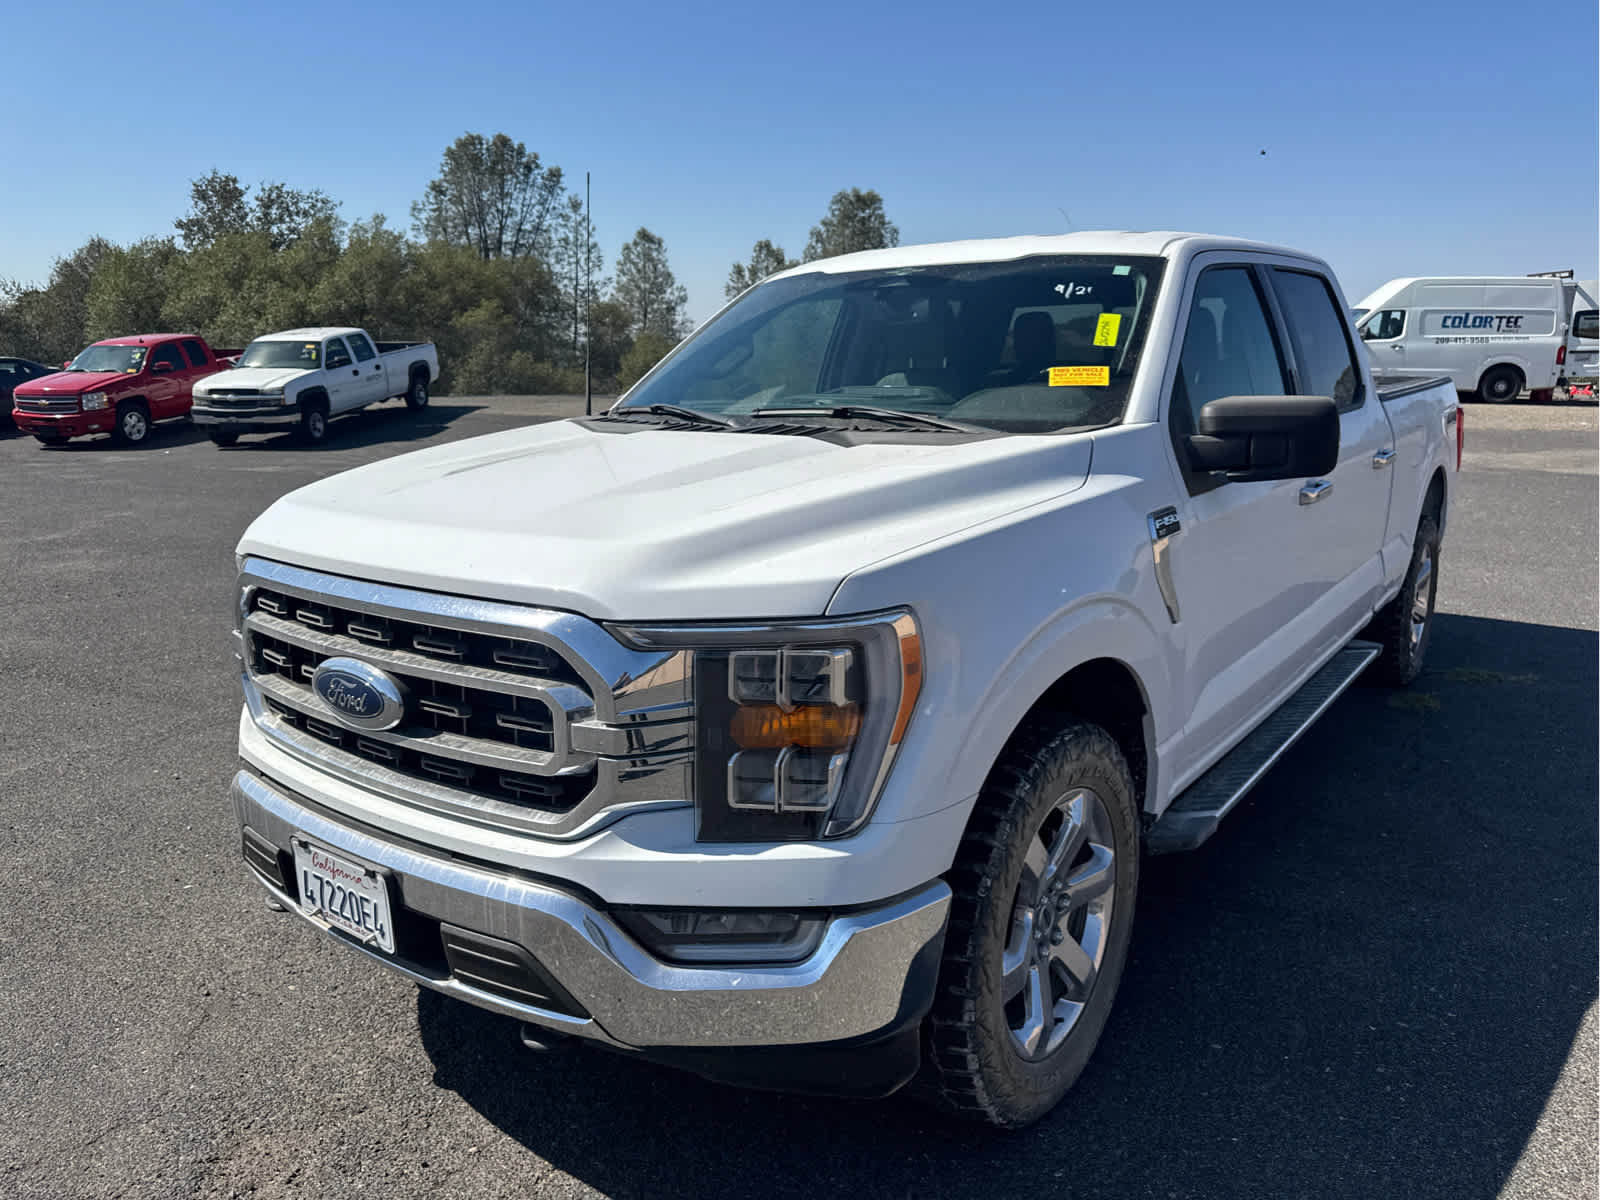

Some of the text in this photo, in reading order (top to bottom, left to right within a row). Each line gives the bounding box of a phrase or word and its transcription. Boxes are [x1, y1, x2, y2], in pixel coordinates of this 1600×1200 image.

[327, 677, 368, 712] Ford
[312, 851, 362, 884] California
[303, 869, 386, 940] 47220E4
